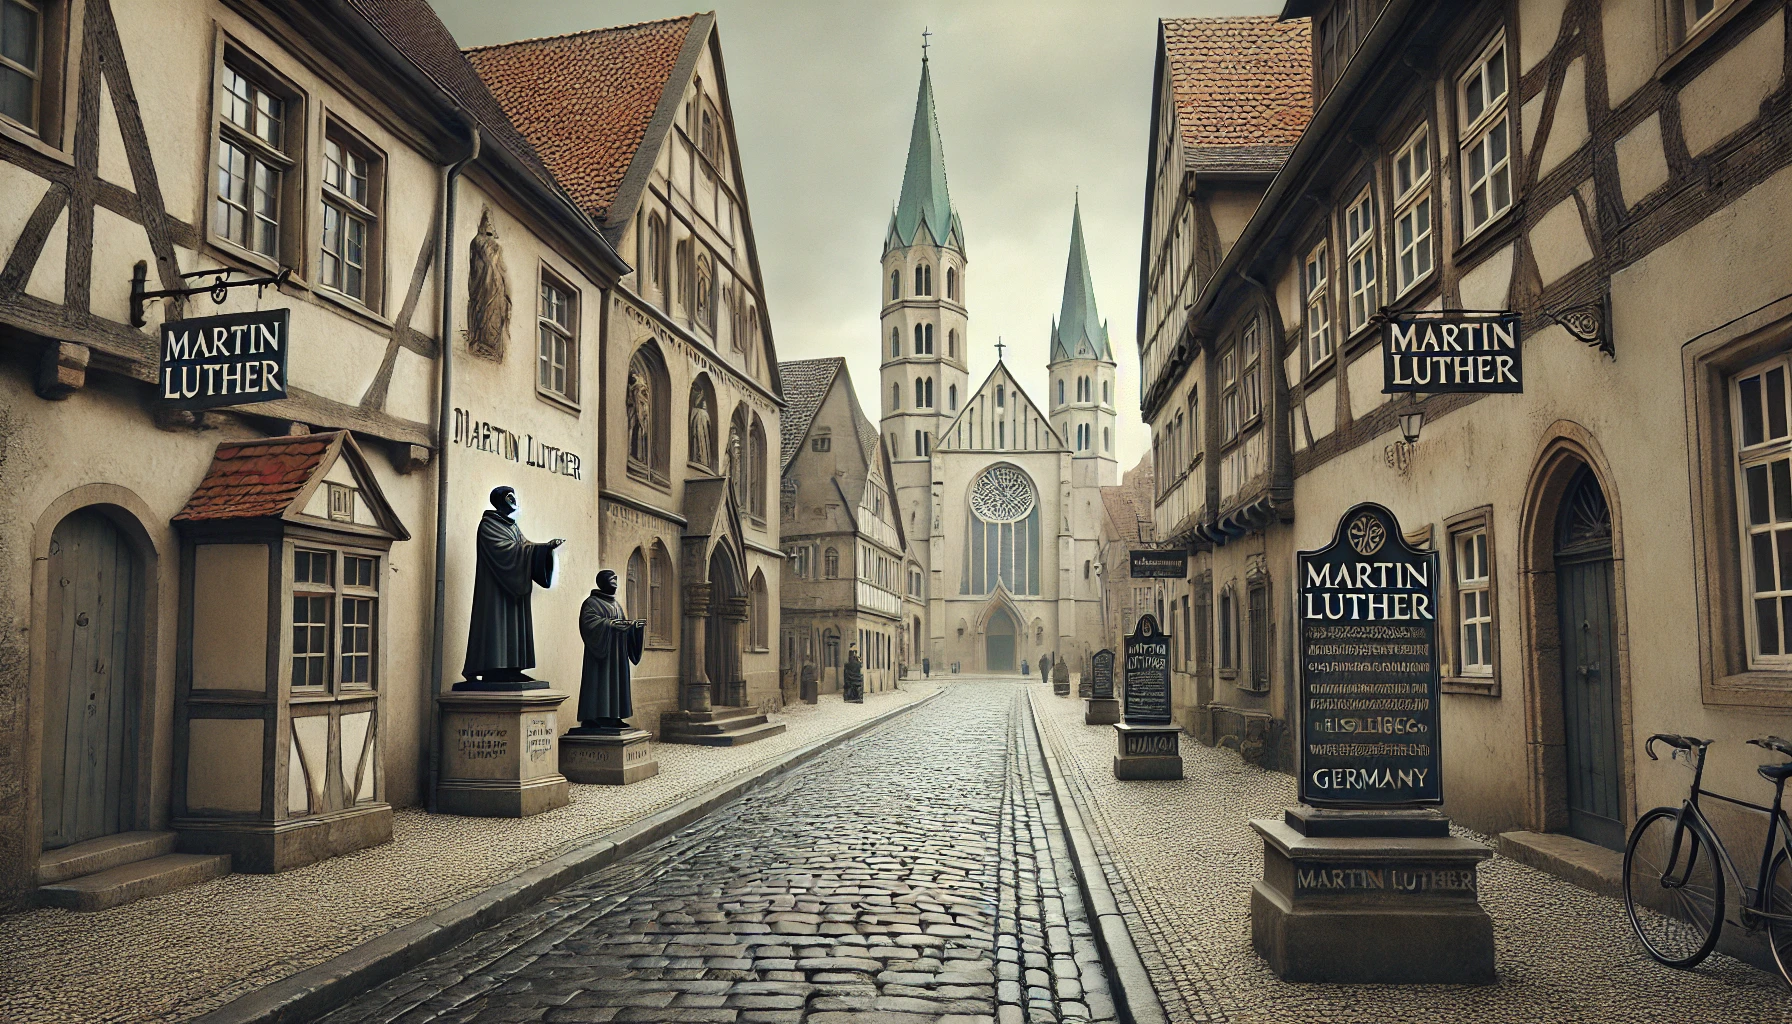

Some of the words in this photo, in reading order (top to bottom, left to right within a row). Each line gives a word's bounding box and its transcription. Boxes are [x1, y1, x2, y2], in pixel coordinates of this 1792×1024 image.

[164, 321, 282, 362] MARTIN
[1391, 322, 1515, 352] MARTIN
[164, 360, 283, 399] LUTHER
[1392, 354, 1519, 385] LUTHER
[1306, 561, 1429, 589] MARTIN
[1304, 593, 1435, 621] LUTHER
[1312, 767, 1429, 790] GERMANY
[1297, 868, 1385, 890] MARTIN
[1392, 869, 1476, 892] LUTHER
